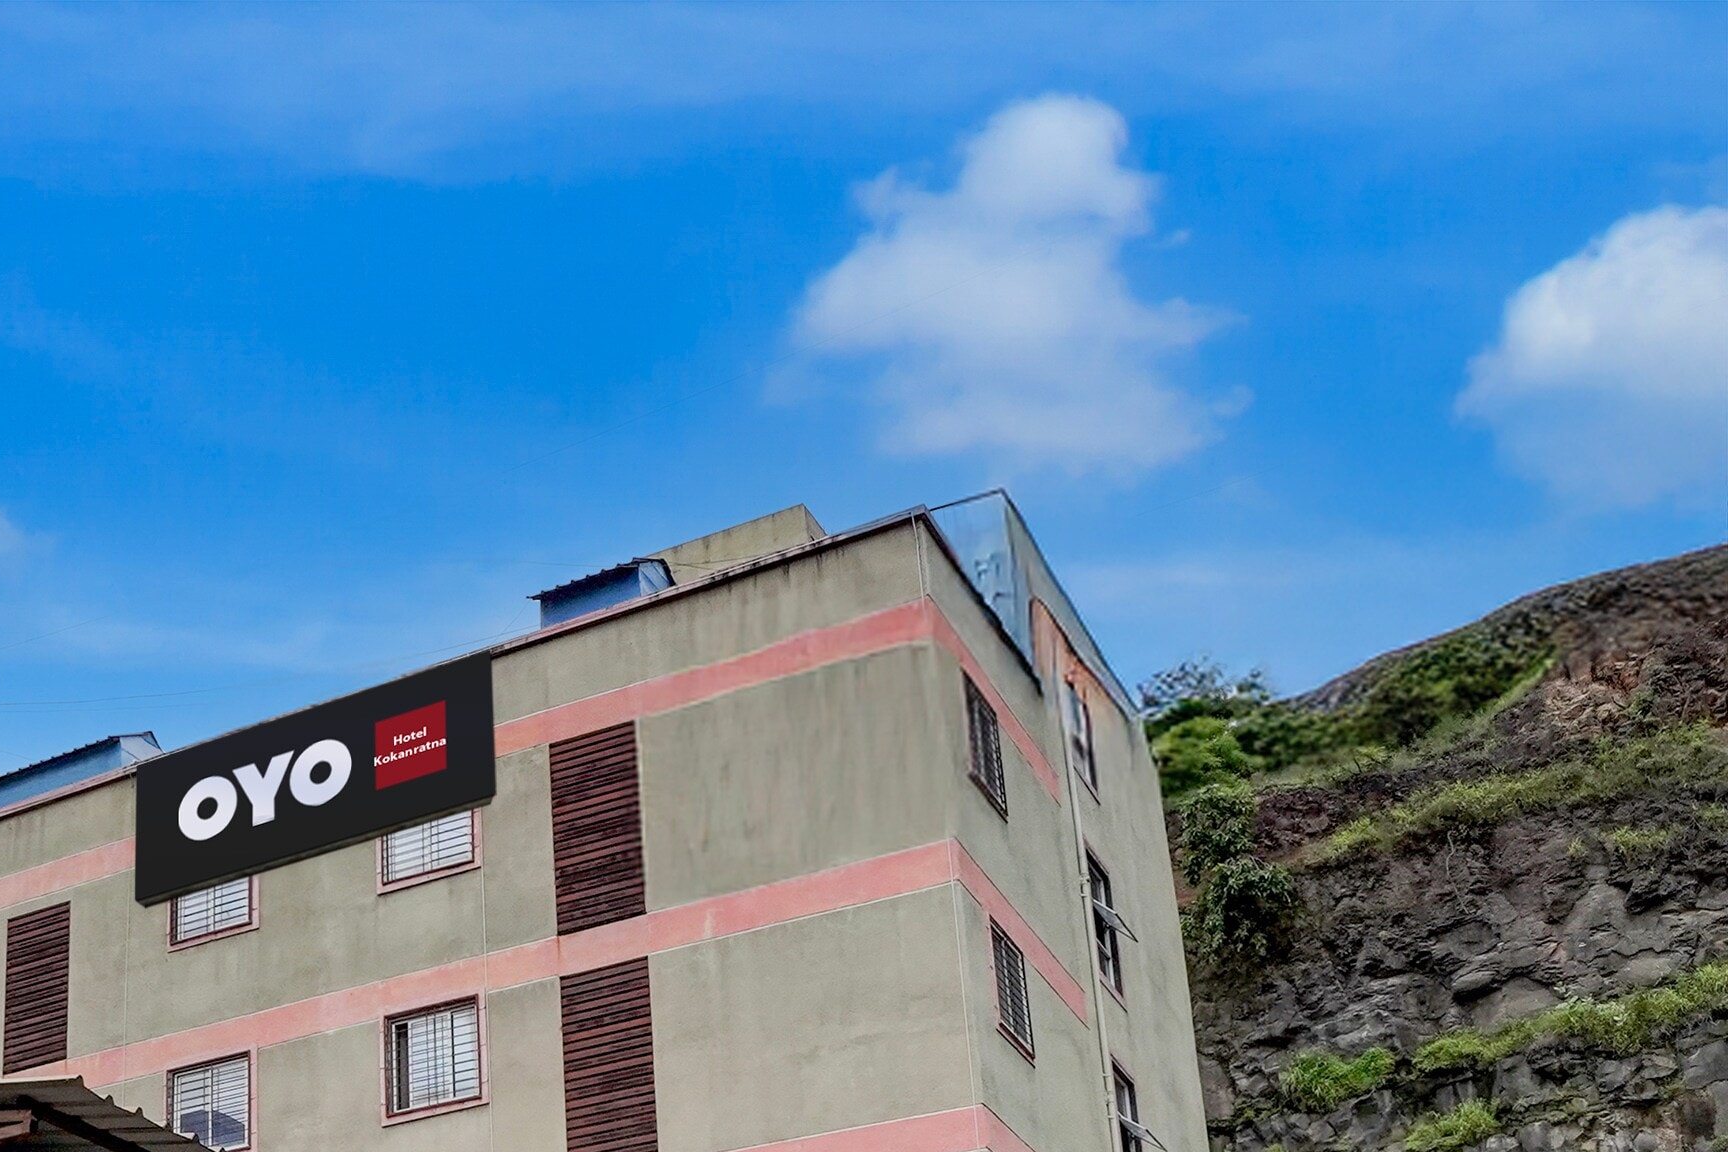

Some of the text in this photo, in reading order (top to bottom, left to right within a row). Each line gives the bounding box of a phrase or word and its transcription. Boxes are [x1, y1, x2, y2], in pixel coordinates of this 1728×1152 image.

[373, 736, 447, 767] Kokanratna
[392, 726, 427, 746] Hotel
[178, 739, 352, 841] OYO
